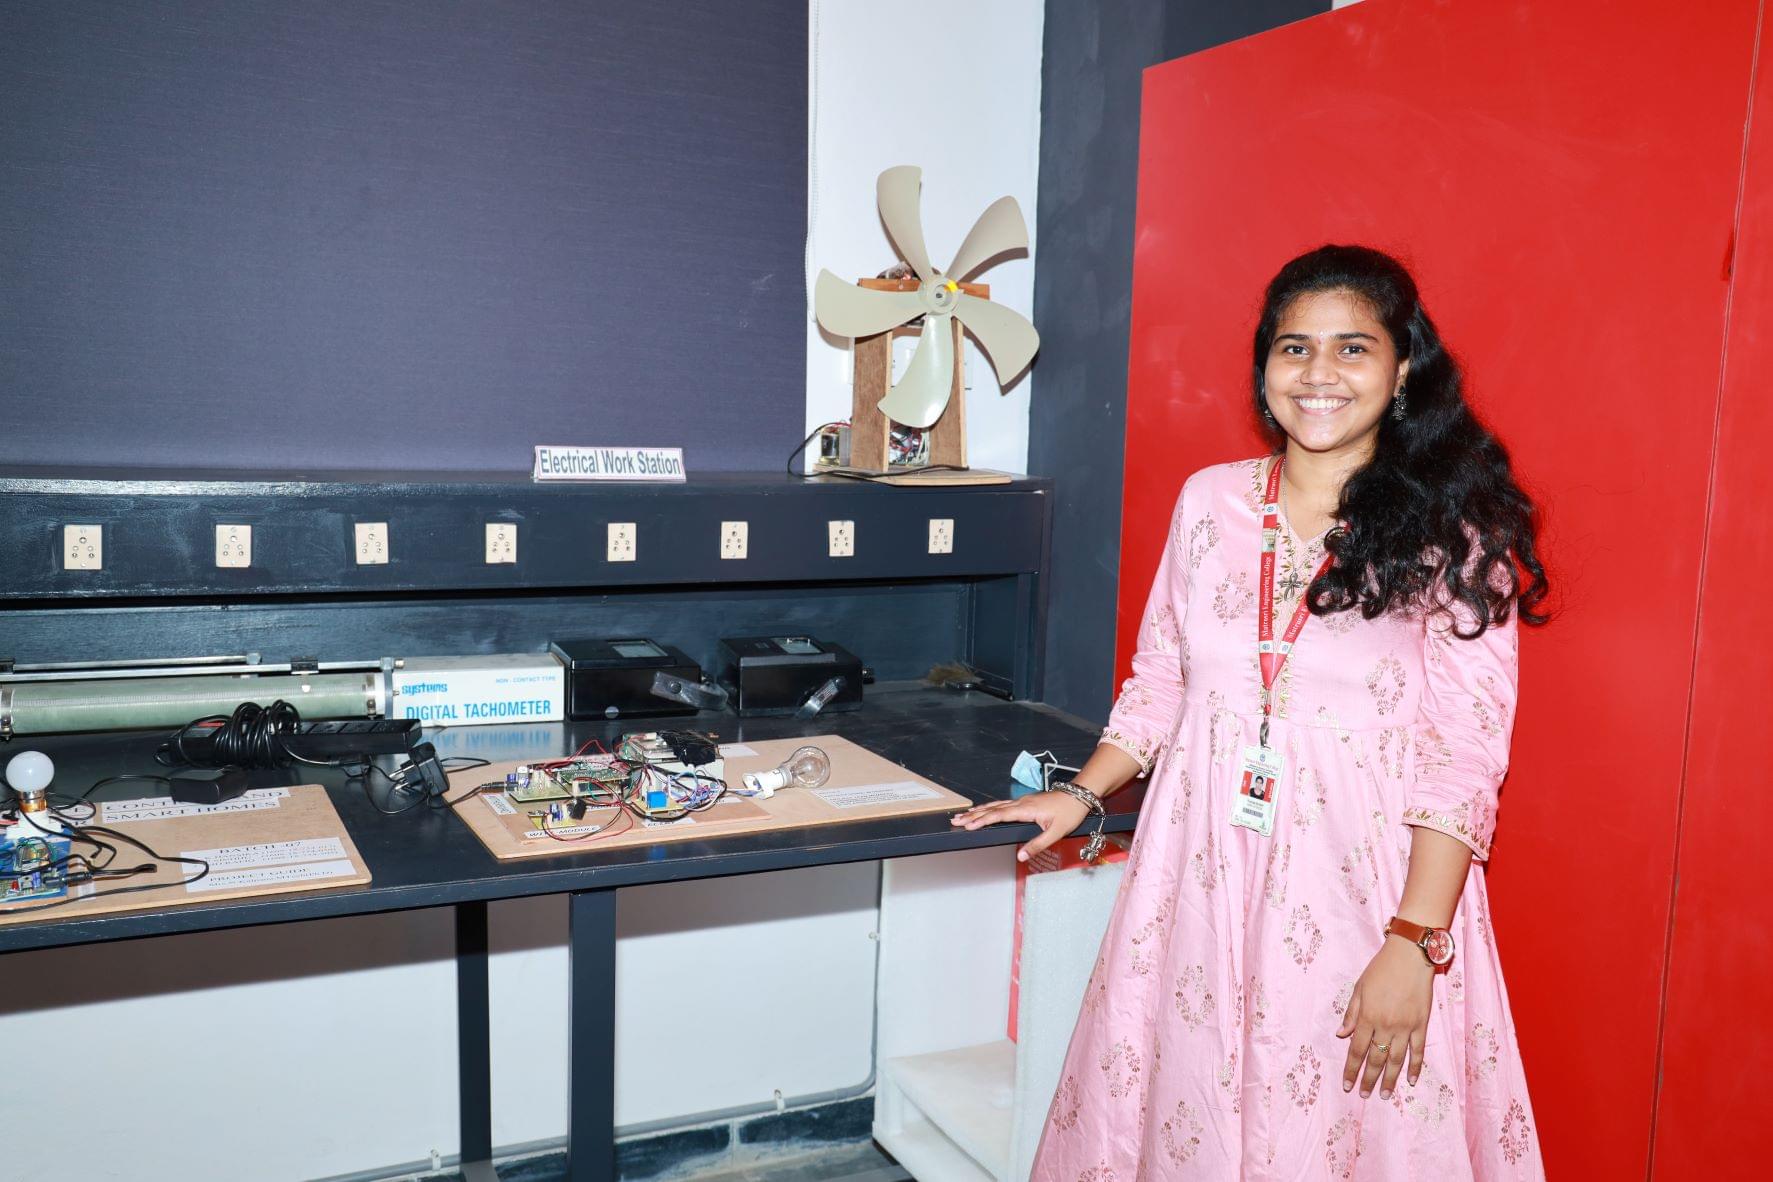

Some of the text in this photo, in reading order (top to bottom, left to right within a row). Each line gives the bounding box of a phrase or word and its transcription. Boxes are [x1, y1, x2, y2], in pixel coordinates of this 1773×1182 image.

[540, 449, 680, 475] Electrical Work Station
[1262, 579, 1271, 609] Engineering
[401, 683, 448, 696] systems
[406, 700, 551, 720] DIGITAL TACHOMETER
[106, 802, 276, 821] SMART HOMES
